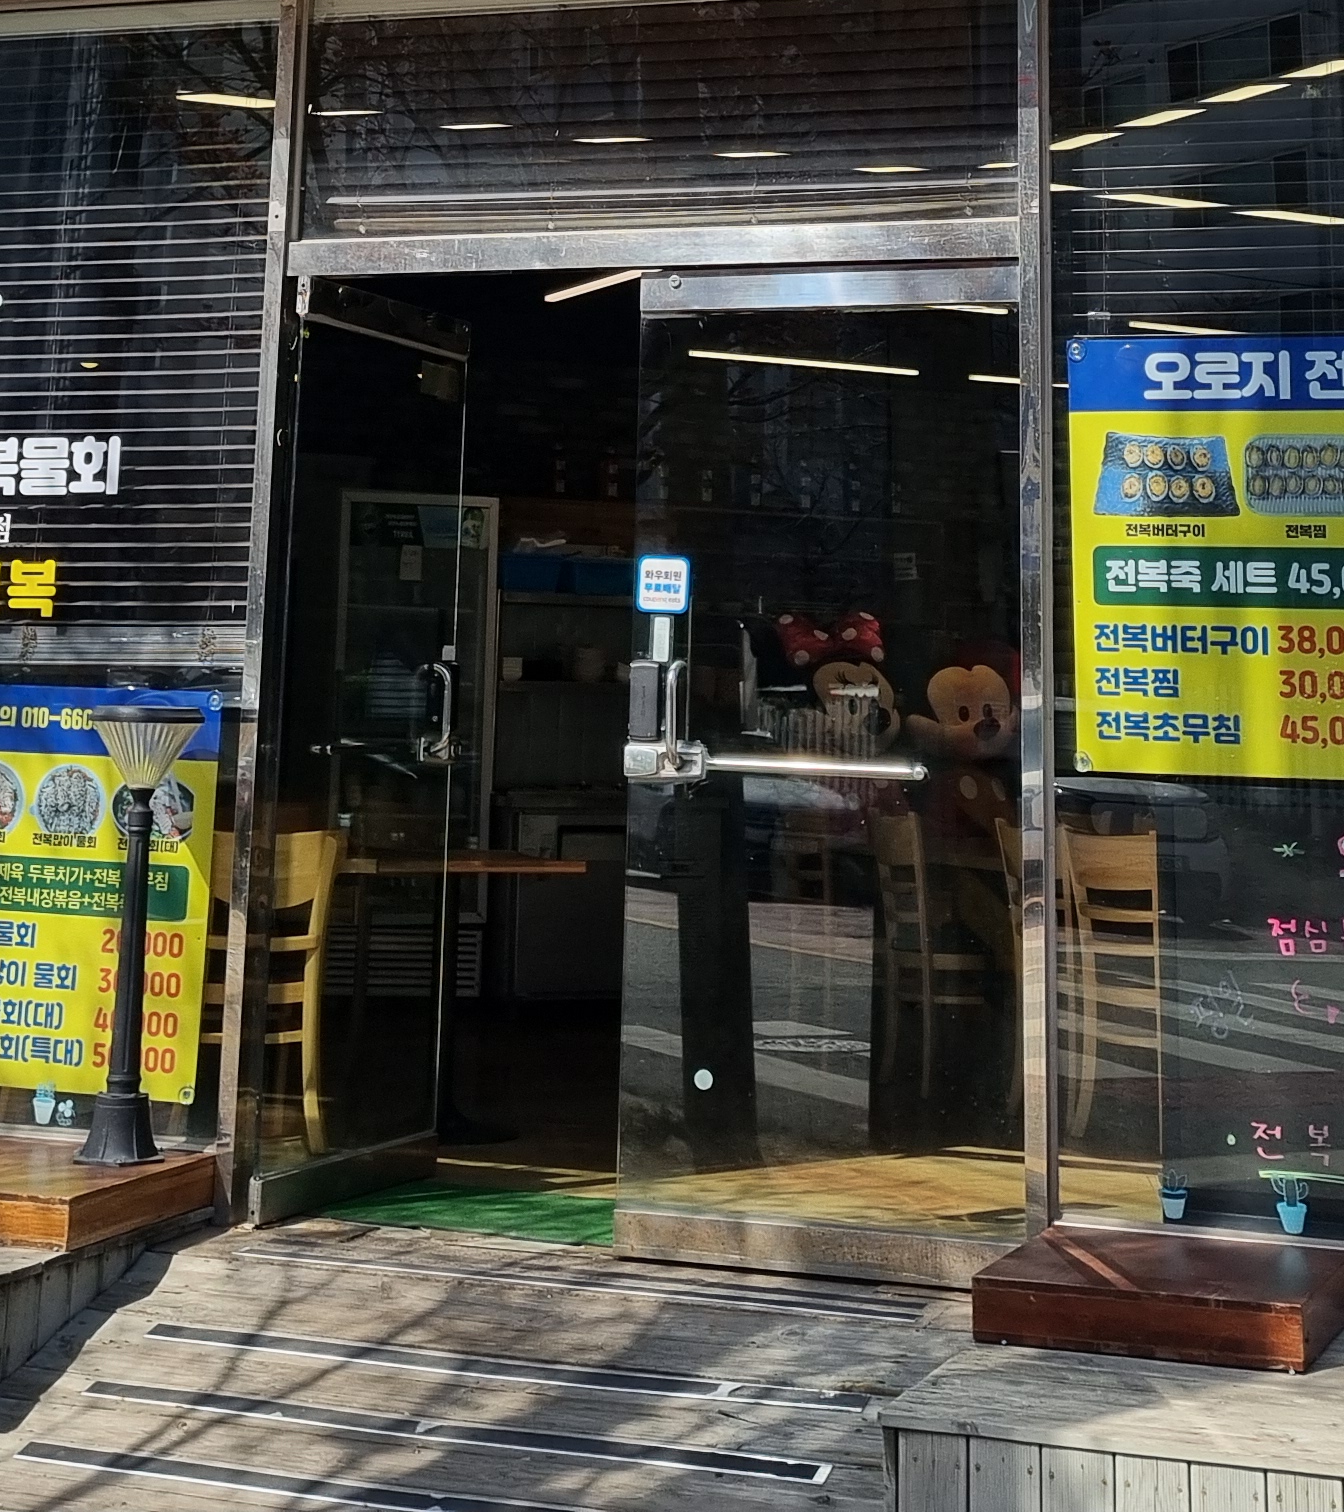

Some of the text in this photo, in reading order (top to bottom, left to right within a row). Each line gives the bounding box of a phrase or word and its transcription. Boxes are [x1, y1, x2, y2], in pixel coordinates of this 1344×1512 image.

[1143, 350, 1291, 400] 오로지
[1125, 523, 1206, 539] 전복버터구이
[1285, 524, 1327, 539] 전복찜
[1105, 558, 1202, 594] 전복죽
[1211, 560, 1278, 594] 세트
[1093, 623, 1269, 656] 전복버터구이
[1094, 667, 1180, 698] 전복찜
[1095, 711, 1241, 745] 전복초무침
[34, 962, 77, 991] 물회
